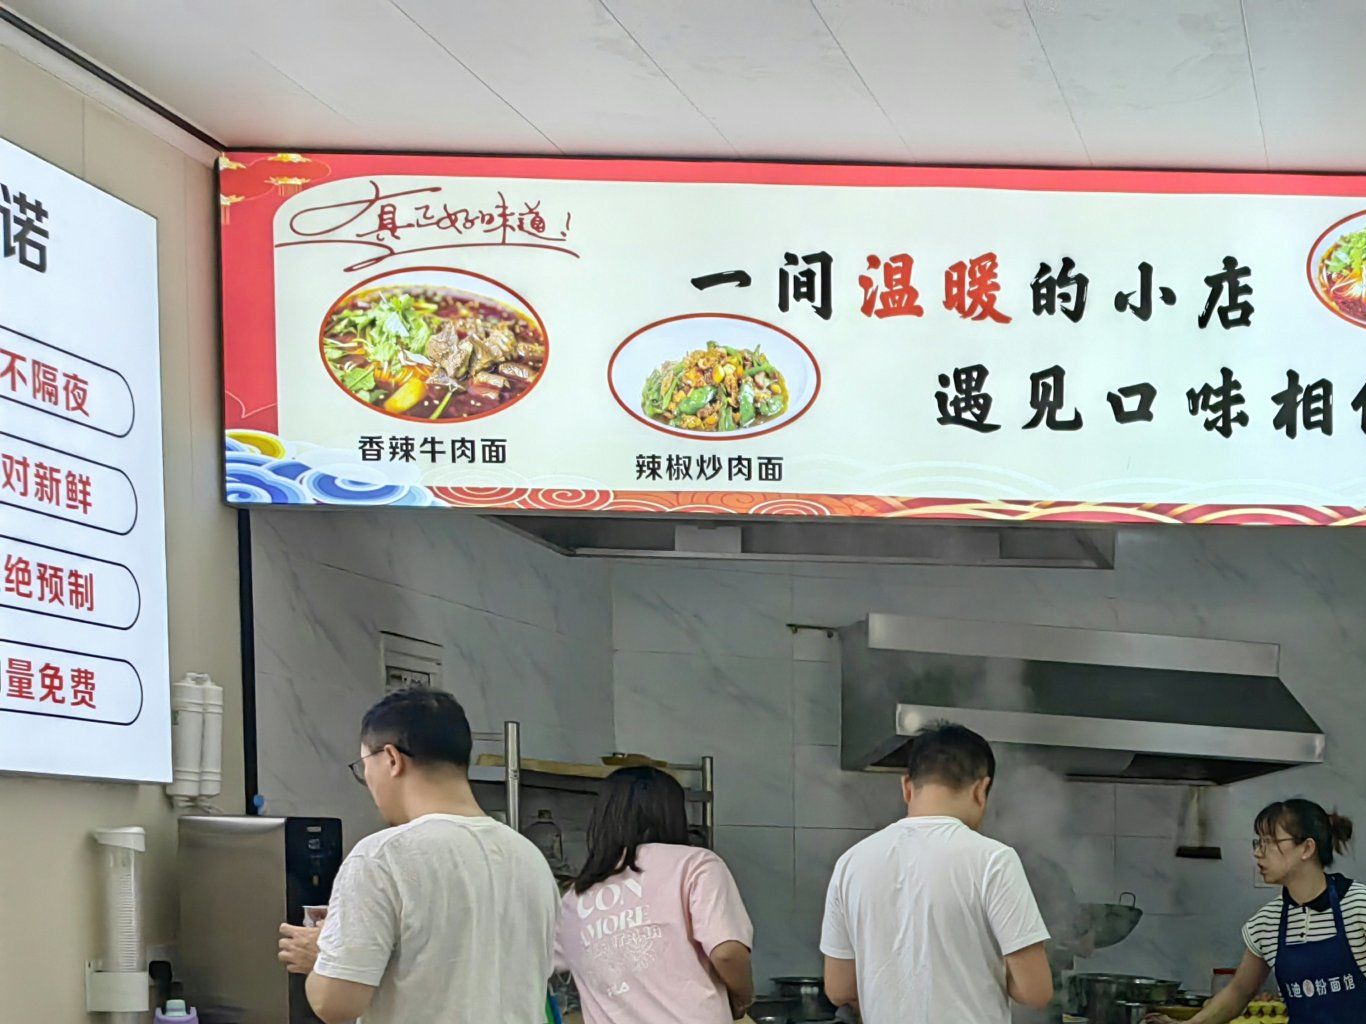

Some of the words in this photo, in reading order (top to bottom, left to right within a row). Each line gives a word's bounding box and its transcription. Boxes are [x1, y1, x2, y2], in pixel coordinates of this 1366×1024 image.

[0, 183, 49, 273] 诺
[691, 251, 1254, 328] 一间温暖的小店
[0, 349, 87, 415] 不隔夜
[359, 436, 506, 463] 香辣牛肉面
[636, 454, 783, 481] 辣椒炒肉面
[2, 454, 92, 513] 对新鲜
[5, 557, 94, 611] 绝预制
[9, 659, 96, 709] 量免费
